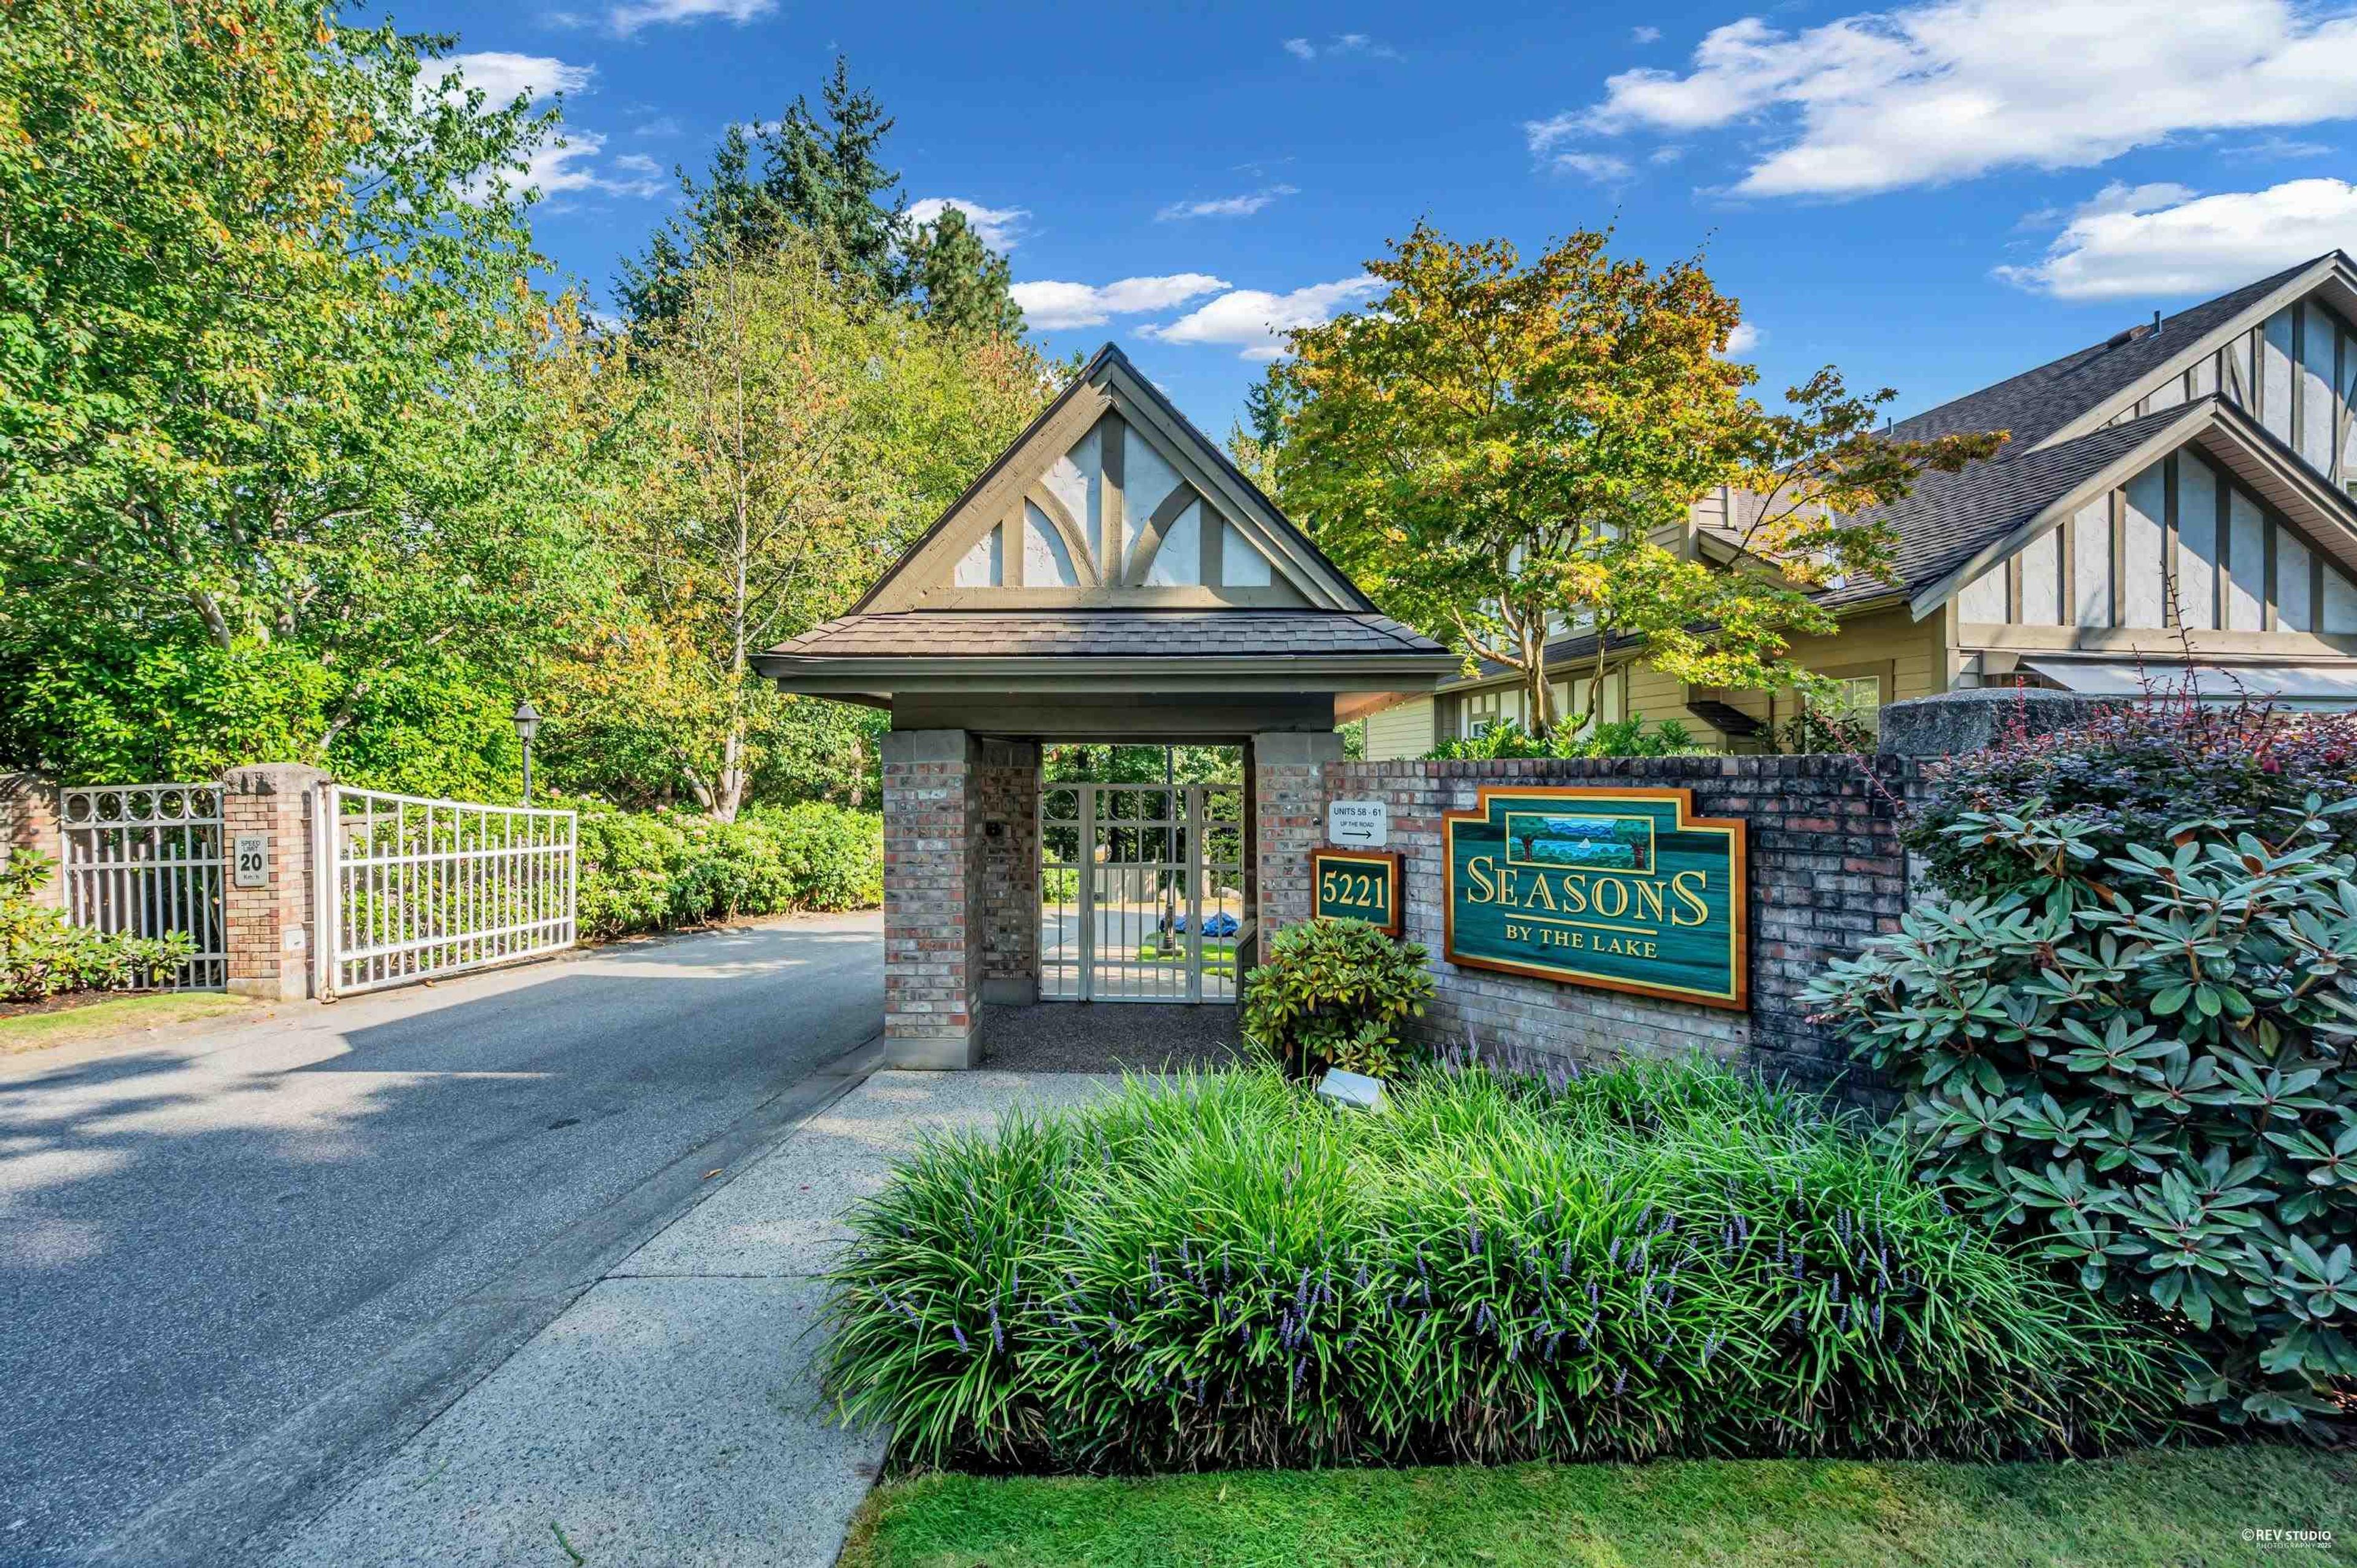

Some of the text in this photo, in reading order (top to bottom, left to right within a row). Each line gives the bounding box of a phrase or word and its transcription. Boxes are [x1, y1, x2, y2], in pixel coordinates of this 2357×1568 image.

[1372, 808, 1381, 817] 61
[241, 854, 262, 871] 20
[1322, 870, 1385, 909] 5221
[1467, 855, 1709, 927] SEASONS
[1505, 924, 1657, 959] BY THE LAKE
